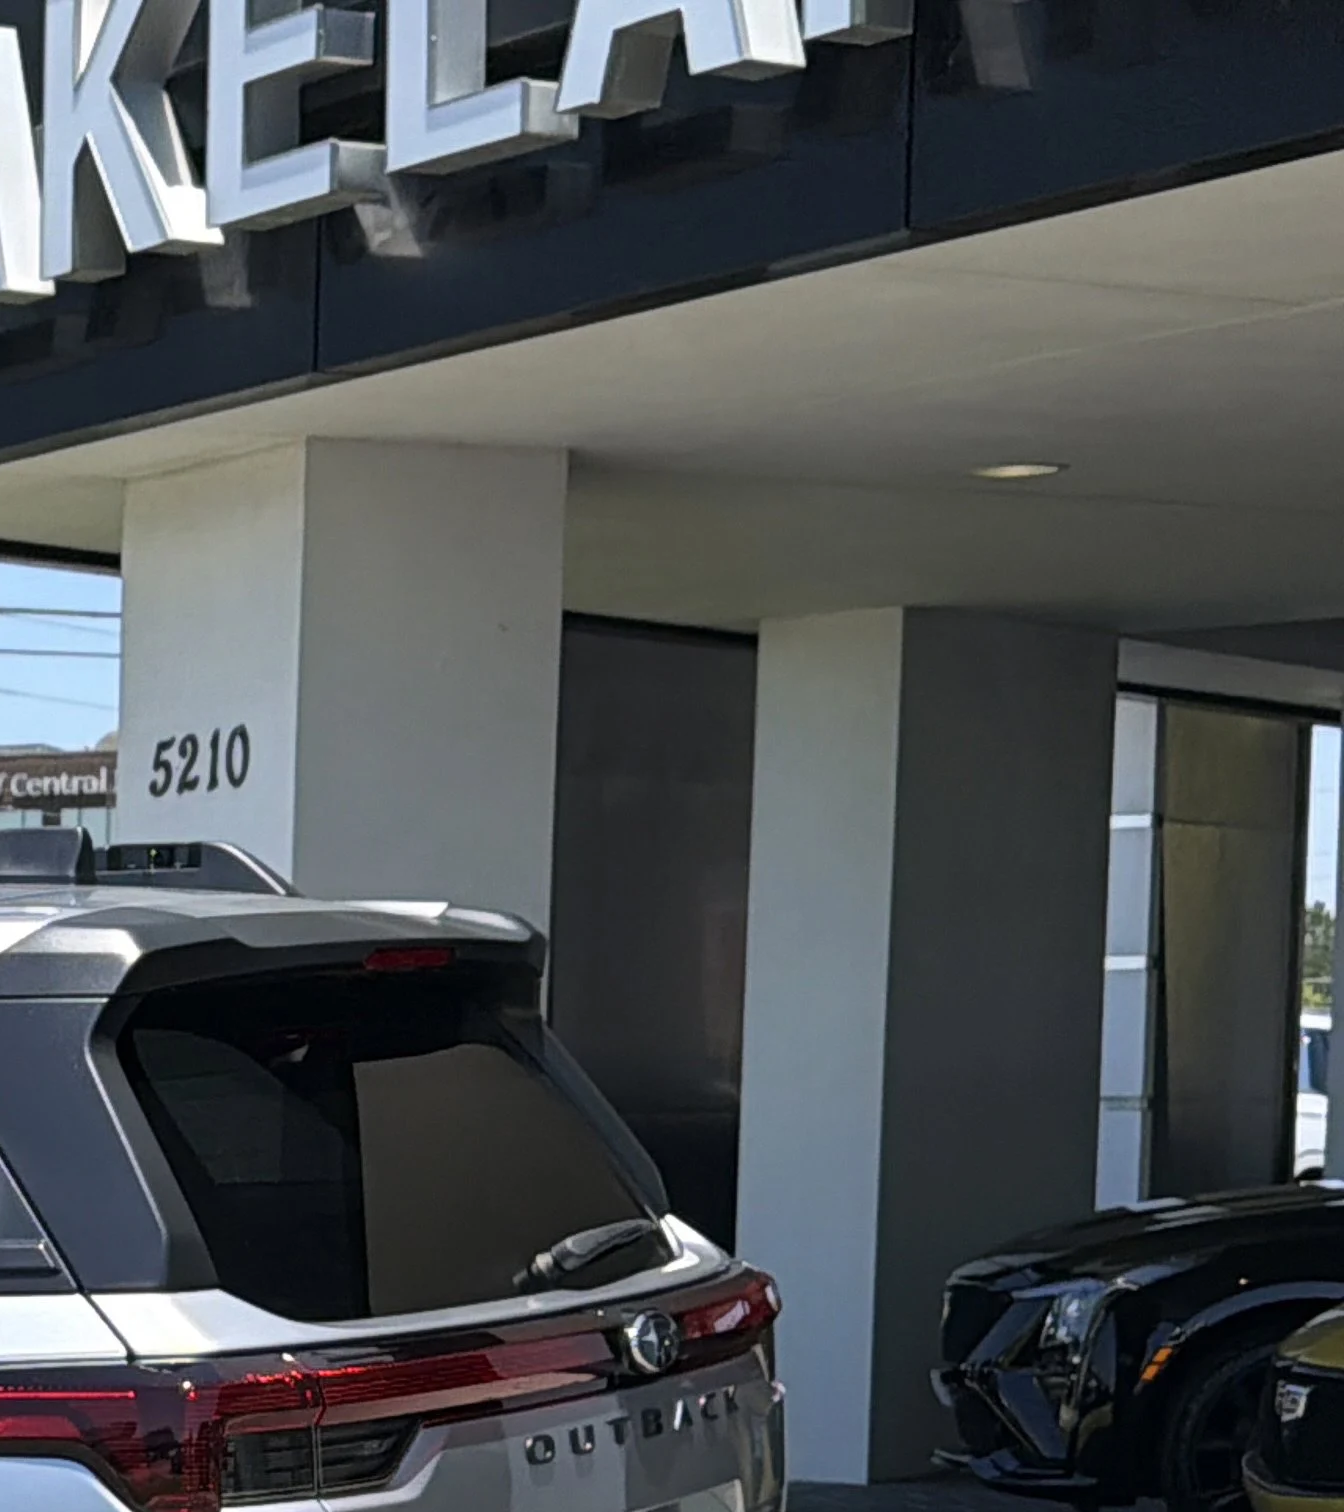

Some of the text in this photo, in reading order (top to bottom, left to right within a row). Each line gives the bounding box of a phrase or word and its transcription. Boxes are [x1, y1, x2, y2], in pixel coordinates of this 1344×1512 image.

[9, 765, 108, 798] Central
[147, 722, 252, 798] 5210
[523, 1384, 740, 1466] OUTBACK
